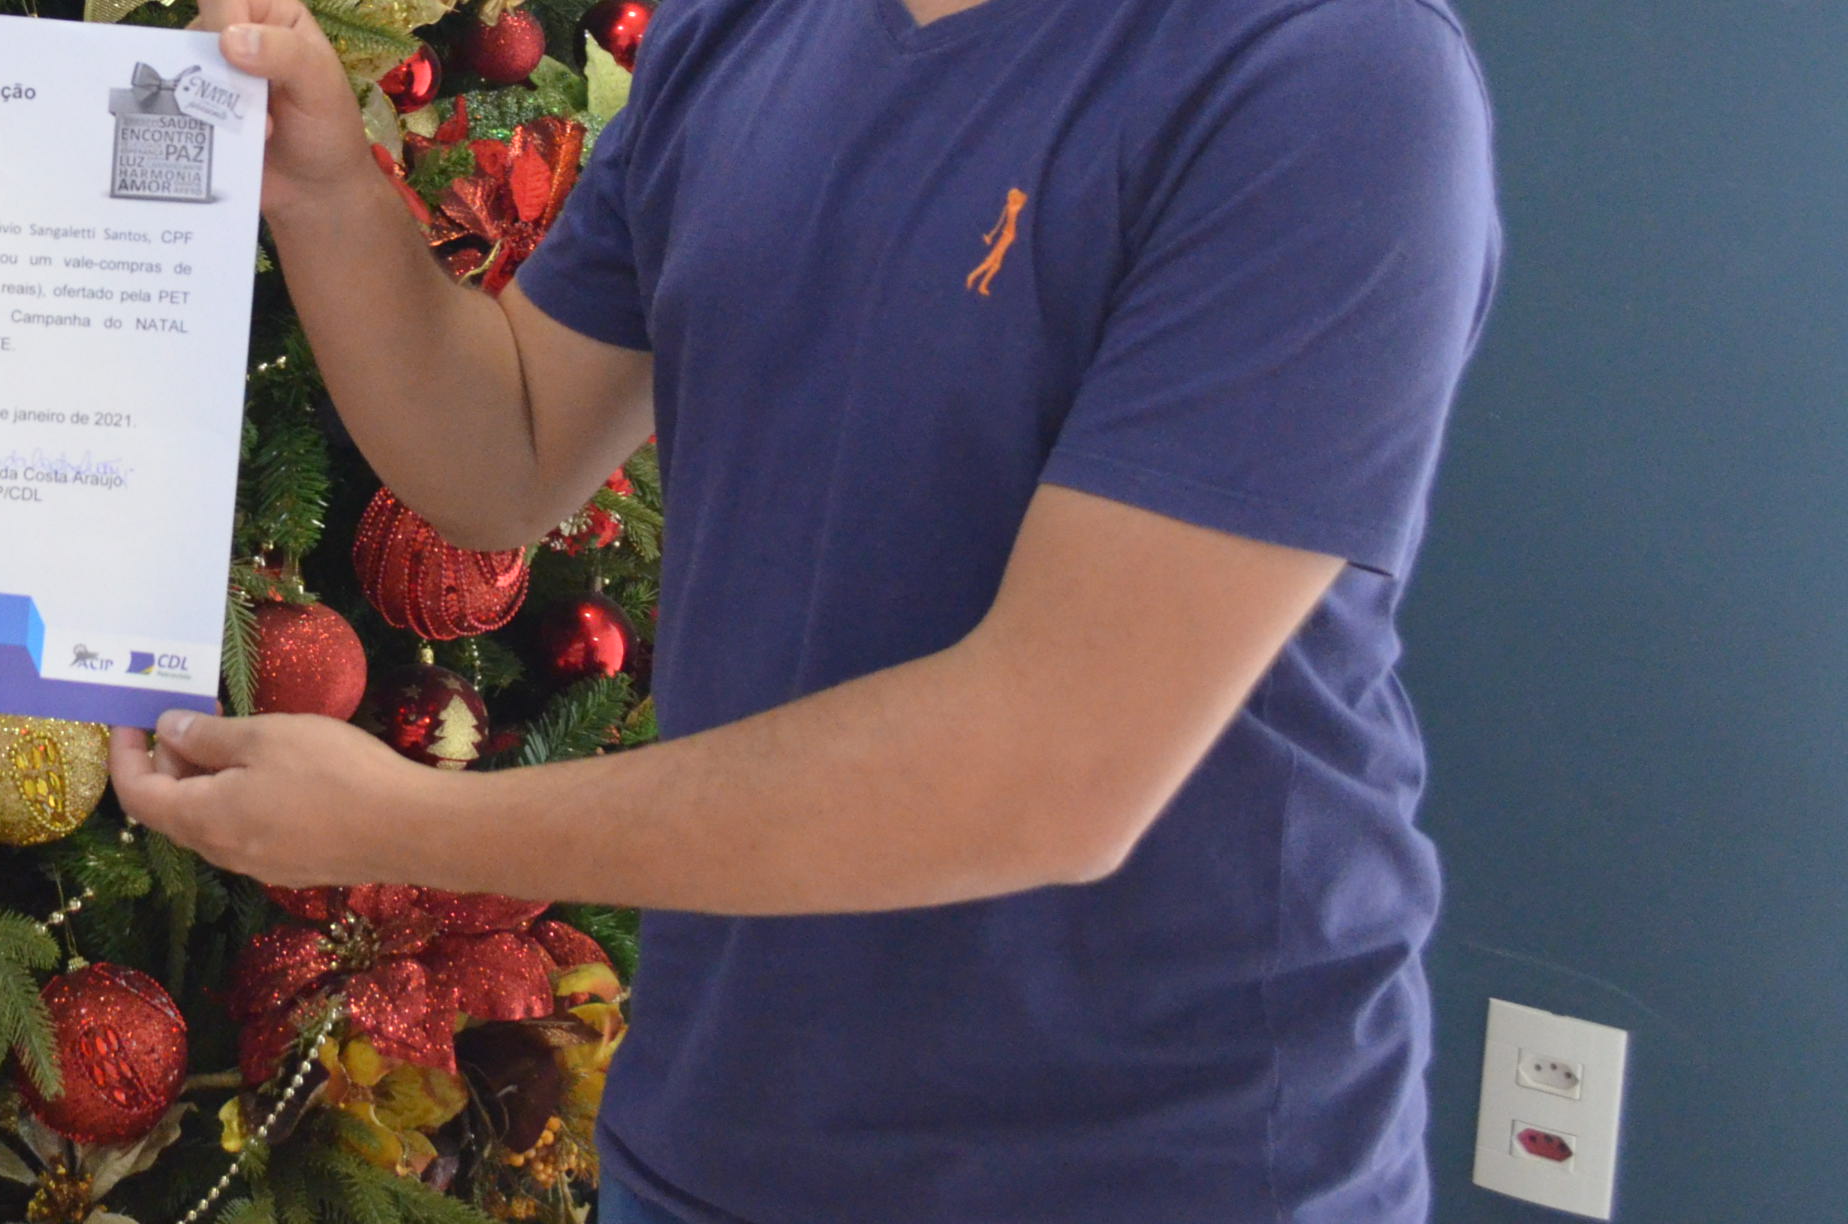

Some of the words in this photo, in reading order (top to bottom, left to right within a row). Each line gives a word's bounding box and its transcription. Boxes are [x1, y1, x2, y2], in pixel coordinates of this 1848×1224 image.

[120, 127, 207, 145] ENCONTRO
[119, 155, 146, 168] LUZ
[164, 143, 205, 163] PAZ
[118, 167, 202, 183] HARMONIA
[117, 178, 172, 194] AMOR
[29, 223, 97, 240] Sangaletti
[103, 227, 152, 244] Santos,
[160, 229, 194, 245] CPF
[29, 254, 53, 266] um
[63, 255, 162, 274] vale-compras
[173, 261, 193, 276] de
[52, 284, 114, 301] ofertado
[119, 289, 152, 304] pela
[158, 289, 191, 305] PET
[10, 308, 91, 328] Campanha
[103, 315, 123, 330] do
[135, 317, 189, 334] NATAL
[12, 407, 66, 424] janeiro
[70, 411, 90, 425] de
[0, 465, 18, 480] da
[23, 466, 67, 484] Costa
[157, 653, 188, 671] CDL
